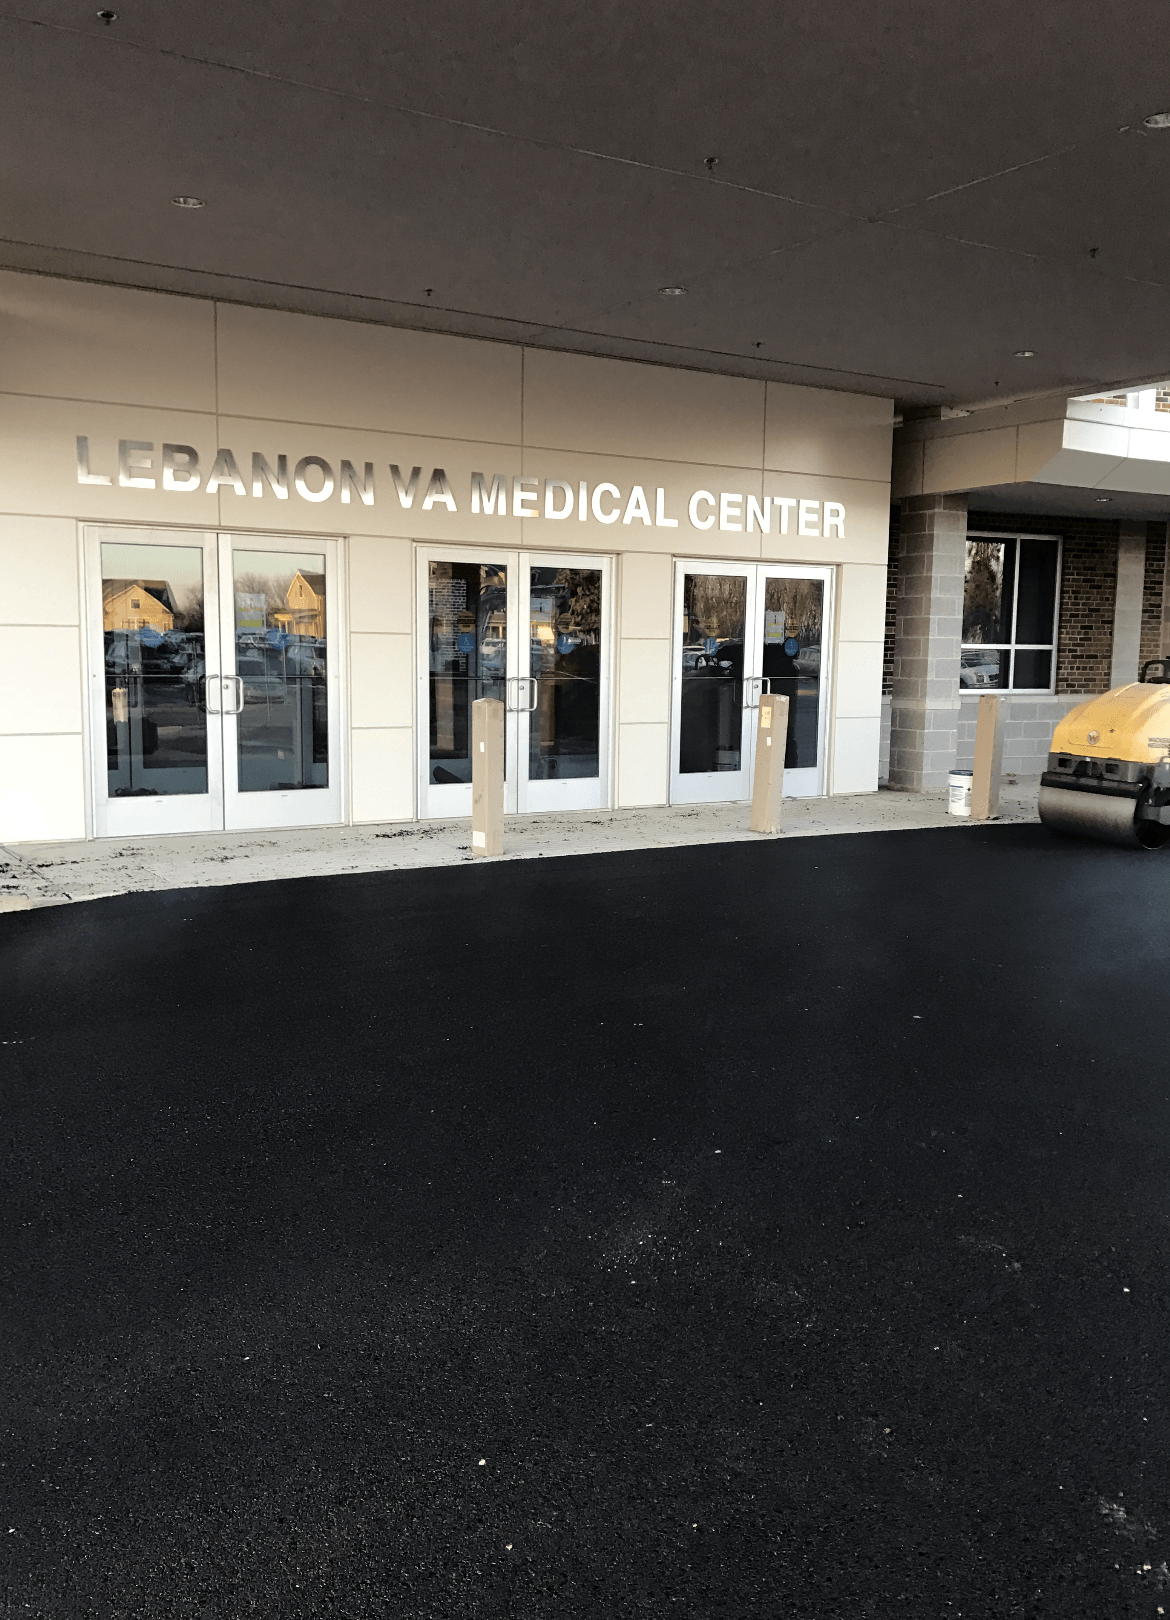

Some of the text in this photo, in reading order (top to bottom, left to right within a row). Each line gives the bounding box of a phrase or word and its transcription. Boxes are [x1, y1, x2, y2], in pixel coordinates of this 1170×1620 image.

[76, 435, 846, 538] LEBANON VA MEDICAL CENTER
